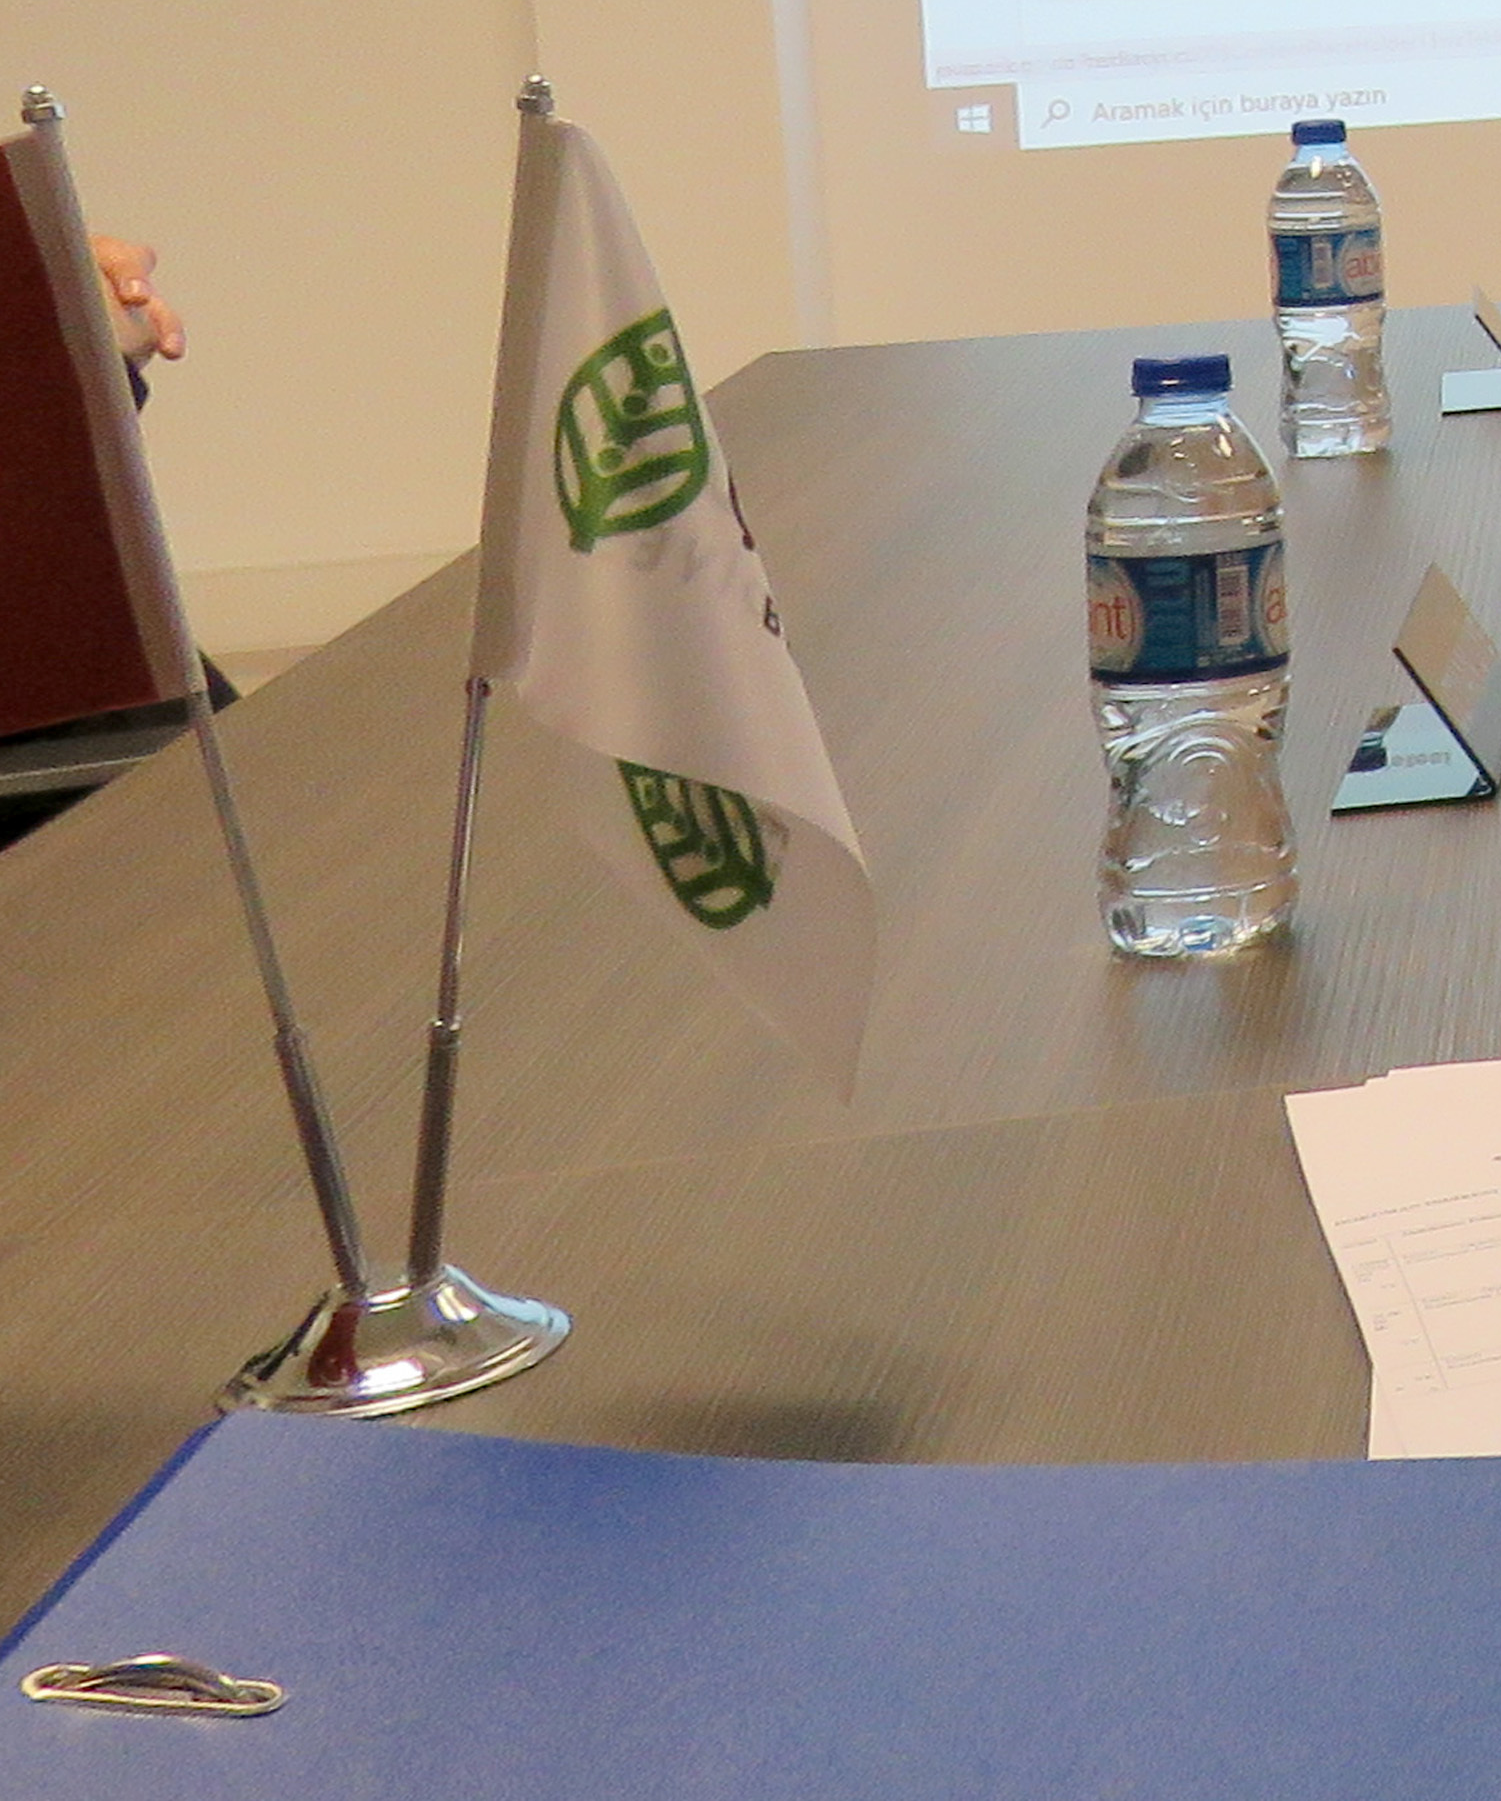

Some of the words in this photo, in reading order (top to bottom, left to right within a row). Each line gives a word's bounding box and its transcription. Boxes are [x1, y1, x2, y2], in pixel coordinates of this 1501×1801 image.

[1092, 98, 1185, 123] Aramak
[1191, 94, 1236, 122] için
[1242, 92, 1318, 116] buraya
[1325, 86, 1386, 112] yazın
